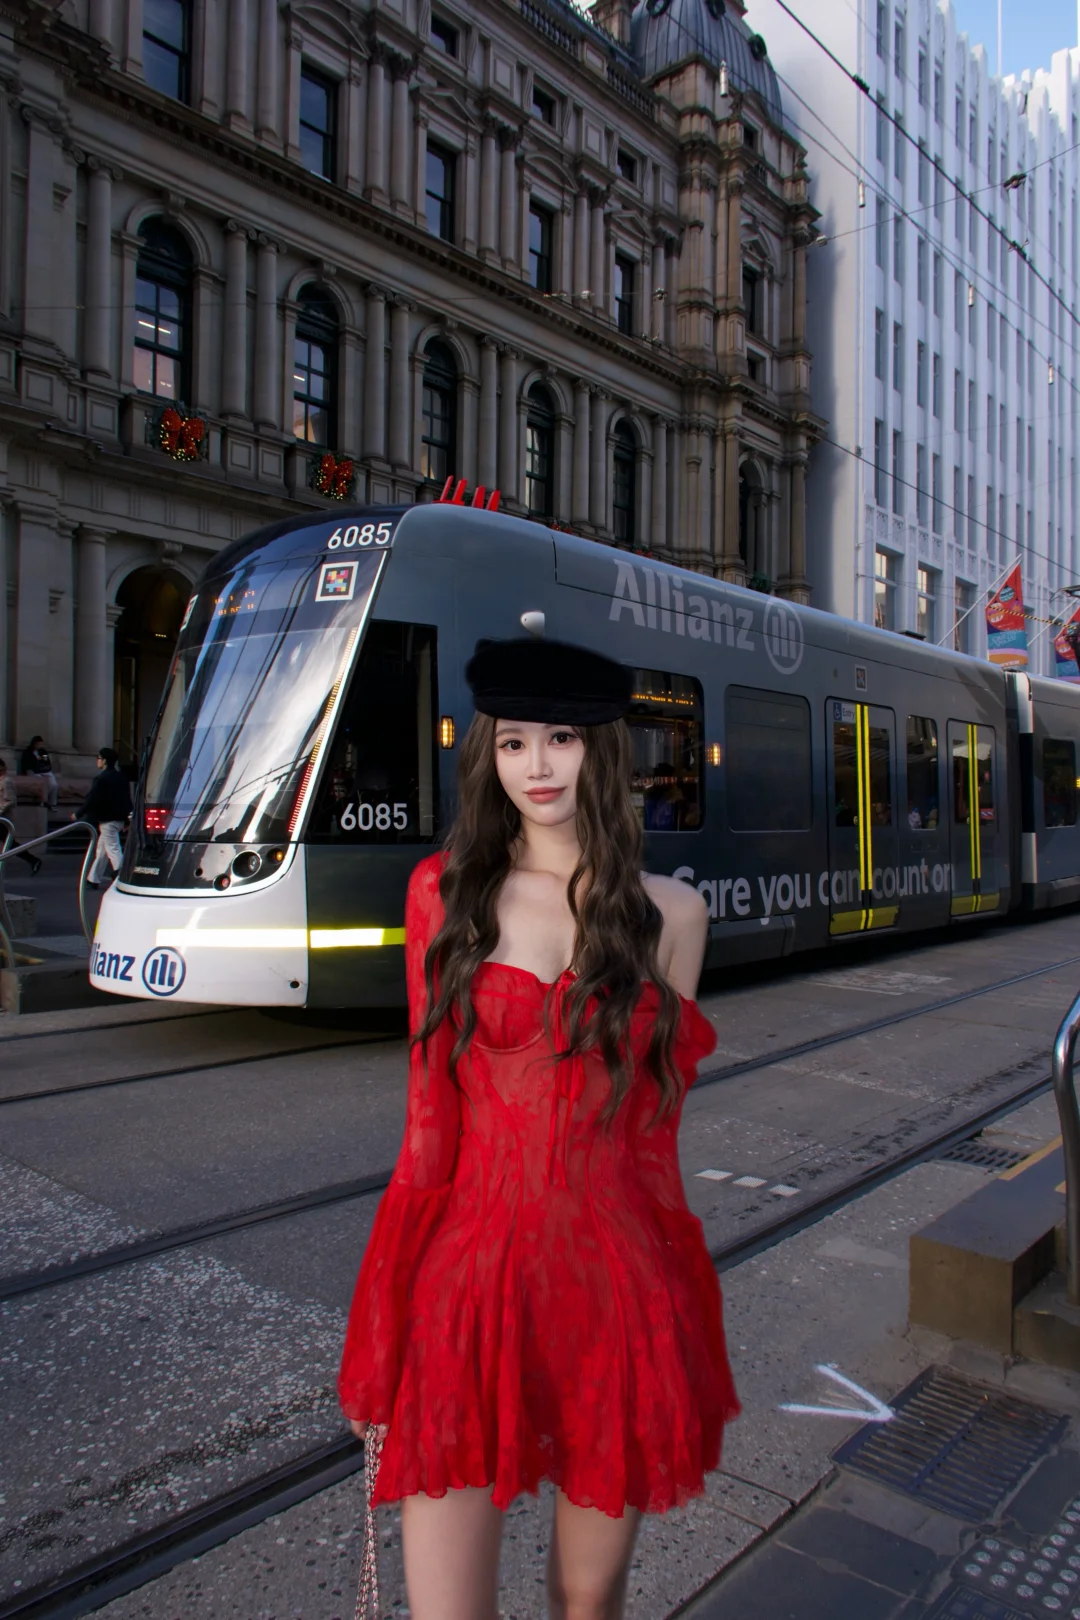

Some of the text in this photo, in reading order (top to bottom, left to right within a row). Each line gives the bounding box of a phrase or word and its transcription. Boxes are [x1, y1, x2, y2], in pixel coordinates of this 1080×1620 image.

[327, 522, 393, 549] 6085
[608, 558, 755, 652] Allianz
[340, 802, 408, 831] 6085
[757, 872, 812, 926] you
[818, 868, 863, 906] can
[871, 857, 930, 900] count
[932, 862, 955, 893] on
